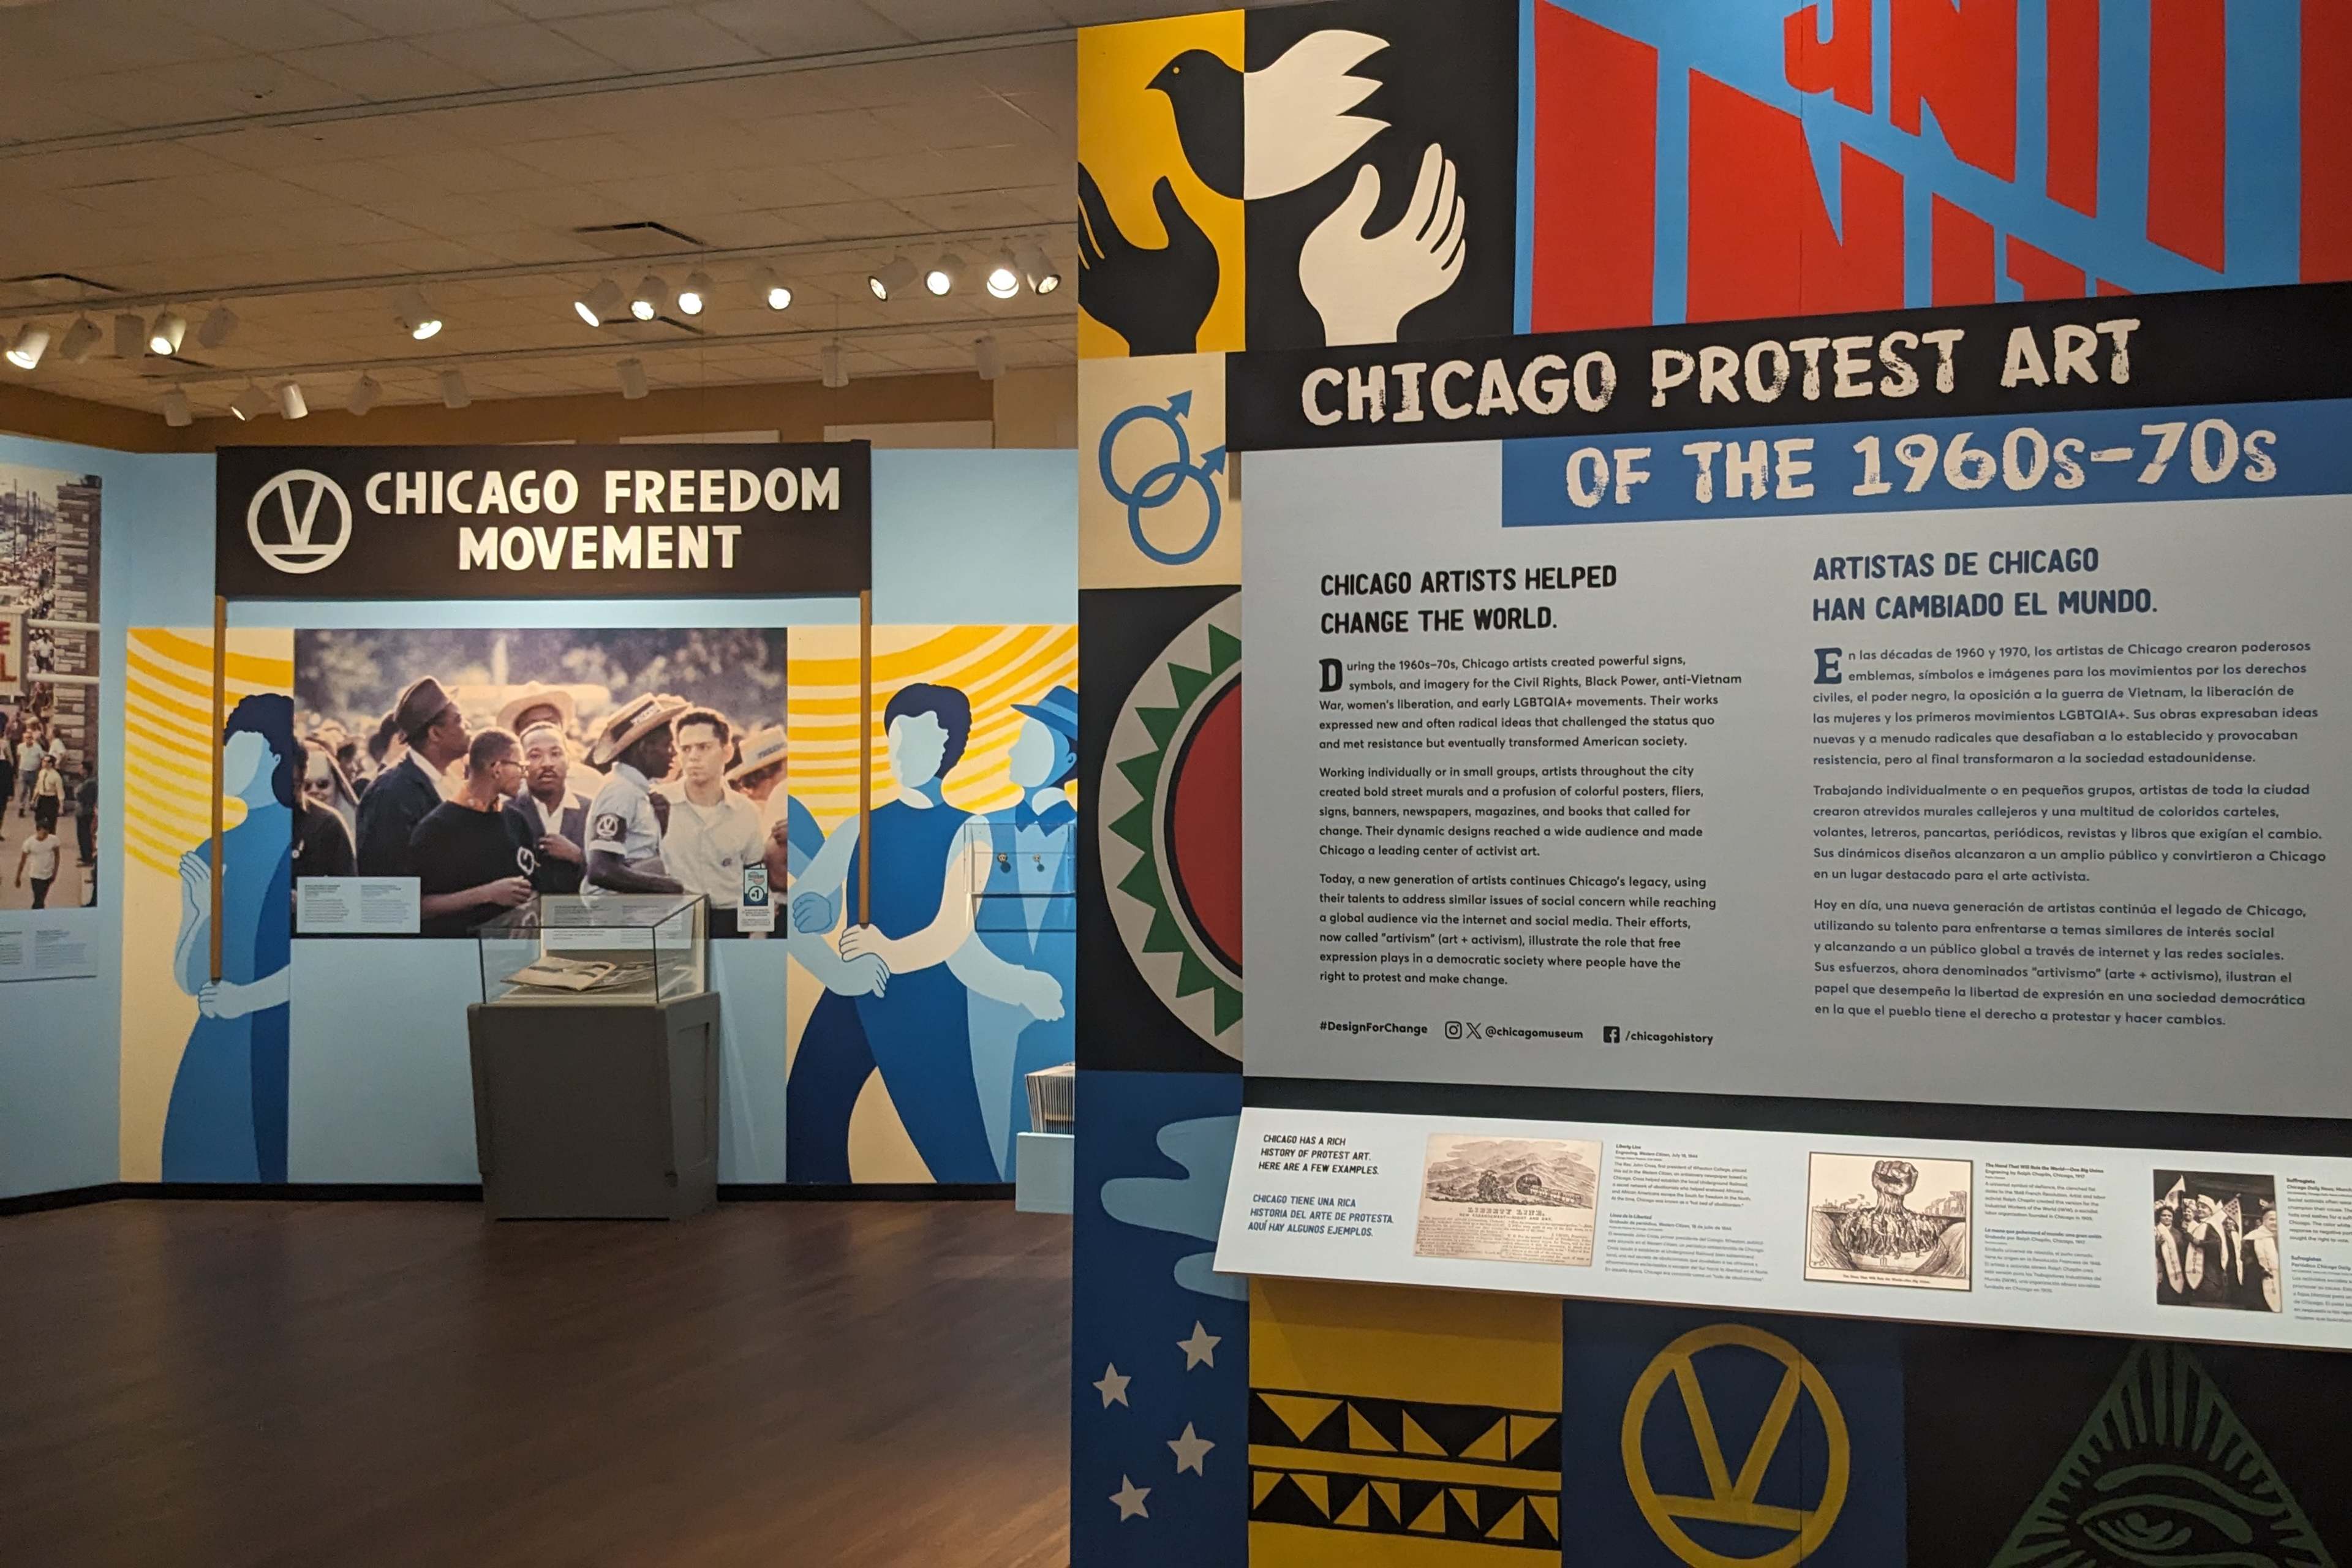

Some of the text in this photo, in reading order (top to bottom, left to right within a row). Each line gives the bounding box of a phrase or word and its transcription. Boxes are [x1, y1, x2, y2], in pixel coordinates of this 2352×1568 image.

[1302, 318, 2141, 426] CHICAGO PROTEST ART
[1566, 447, 1652, 508] OF
[1682, 438, 1814, 503] THE
[365, 467, 839, 514] CHICAGO FREEDOM
[459, 525, 742, 571] MOVEMENT
[1812, 547, 2099, 581] ARTISTAS DE CHICAGO
[1321, 564, 1617, 597] CHICAGO ARTISTS HELPED
[1812, 588, 2158, 622] HAN CAMBIADO EL MUNDO.
[1321, 606, 1558, 635] CHANGE THE WORLD.
[1860, 649, 1877, 660] las
[1880, 648, 1933, 660] décadas
[1936, 647, 1952, 658] de
[1955, 647, 1985, 658] 1960
[1988, 649, 1996, 660] y
[1999, 646, 2030, 658] 1970,
[2034, 646, 2052, 657] los
[2056, 645, 2104, 656] artistas
[2107, 644, 2124, 655] de
[2127, 643, 2183, 657] Chicago
[2186, 644, 2237, 654] crearon
[2241, 640, 2311, 655] poderosos
[1378, 660, 1396, 671] the
[1461, 658, 1509, 671] Chicago
[1512, 657, 1548, 668] artists
[1550, 655, 1595, 667] created
[1598, 654, 1649, 669] powerful
[1653, 654, 1686, 668] signs,
[1349, 674, 1742, 693] symbols, and imagery for the Civil Rights, Black Power, anti-Vietnam
[1319, 693, 1719, 712] War, women's liberation, and early LGBTQIA+ movements. Their works
[1319, 715, 1715, 732] expressed new and often radical ideas that challenged the status quo
[1319, 735, 1687, 750] and met resistance but eventually transformed American society.
[1814, 1003, 2226, 1026] en la que el pueblo tiene el derecho a protestar y hacer cambios.
[1319, 1020, 1428, 1037] #DesignForChange
[1485, 1025, 1583, 1040] @chicagomuseum
[1624, 1030, 1714, 1046] /chicagohistory
[1263, 1134, 1297, 1144] CHICAGO
[1299, 1136, 1316, 1144] HAS
[1327, 1137, 1346, 1145] RICH
[1261, 1148, 1295, 1157] HISTORY
[1311, 1150, 1350, 1159] PROTEST
[1352, 1152, 1370, 1160] ART.
[1258, 1161, 1281, 1170] HERE
[1283, 1162, 1300, 1170] ARE
[1311, 1163, 1329, 1172] FEW
[1332, 1164, 1378, 1174] EXAMPLES.
[1253, 1194, 1355, 1207] CHICAGO TIENE UNA RICA
[1250, 1208, 1393, 1223] HISTORIA DEL ARTE DE PROTESTA.
[1248, 1219, 1373, 1236] AQUÍ HAY ALGUNOS EJEMPLOS.
